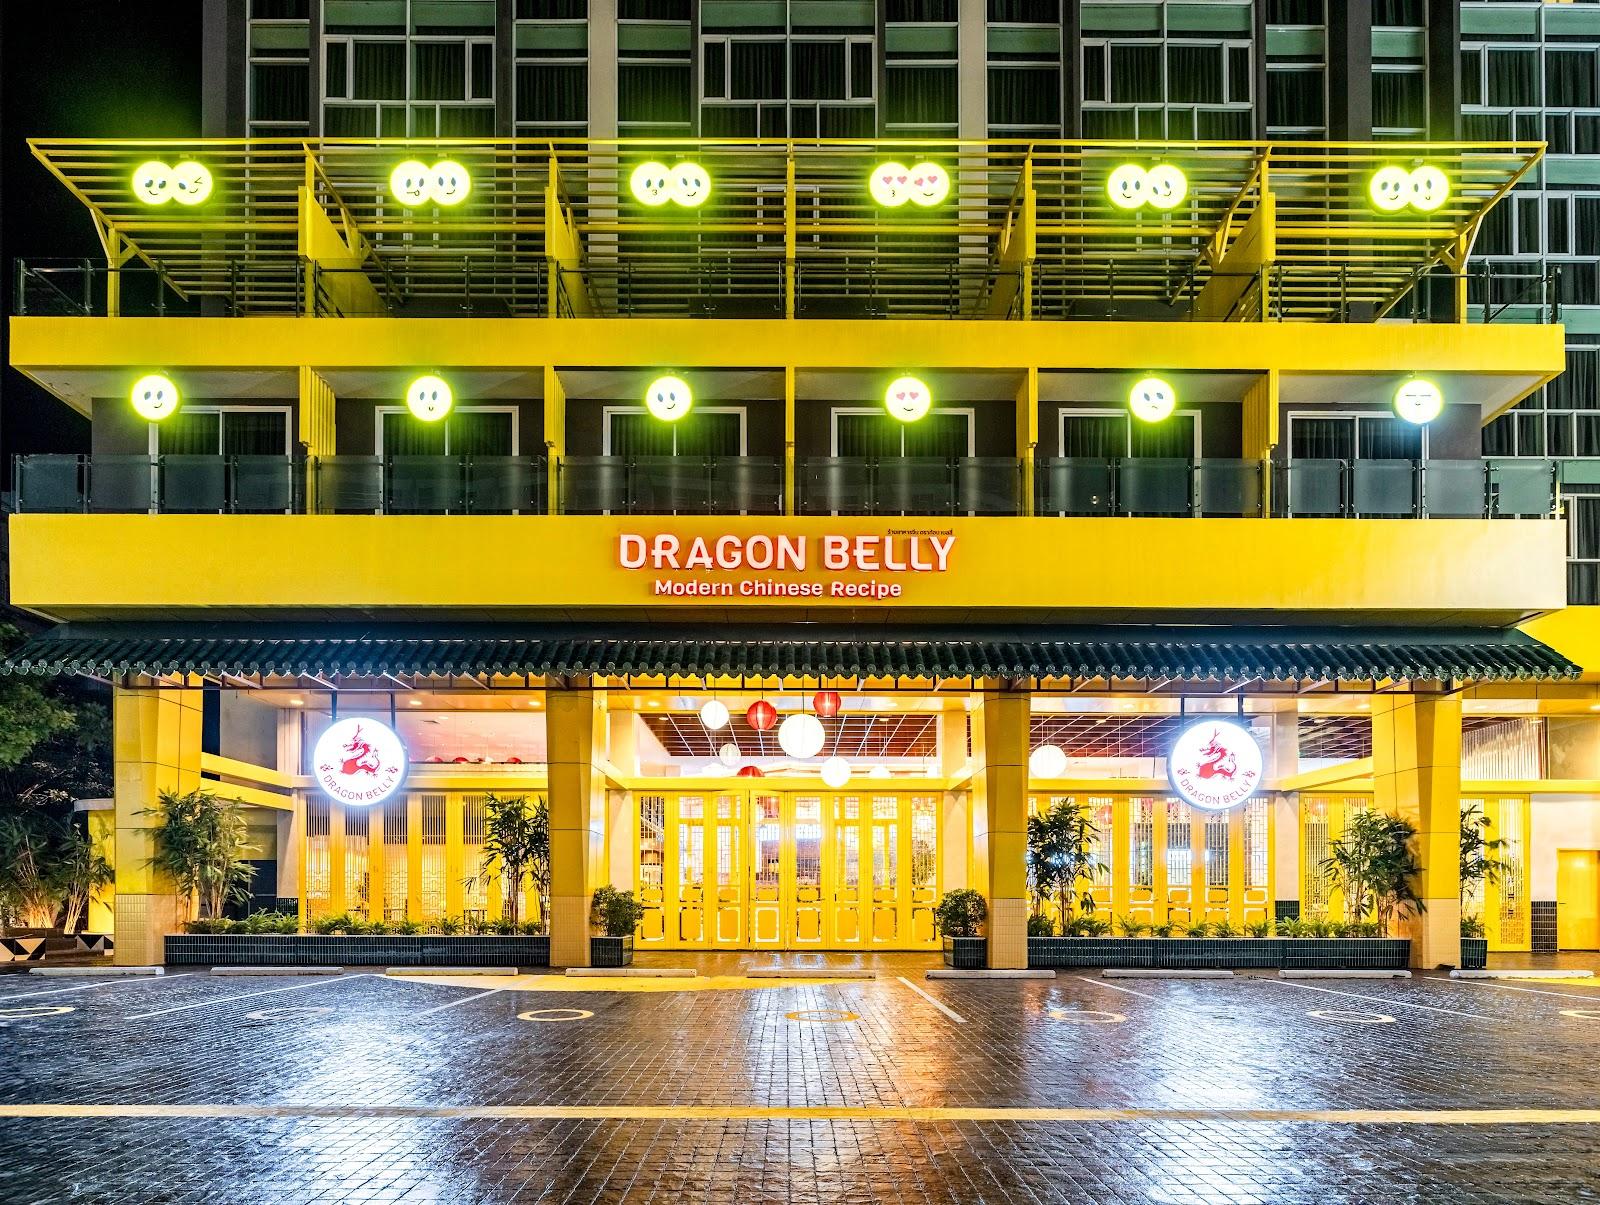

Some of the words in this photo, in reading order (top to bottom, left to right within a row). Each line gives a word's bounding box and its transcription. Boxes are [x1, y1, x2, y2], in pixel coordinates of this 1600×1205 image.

[619, 534, 807, 571] DRAGON
[824, 535, 956, 572] BELLY
[654, 579, 733, 596] Modern
[739, 579, 823, 597] Chinese
[830, 580, 902, 600] Recipe
[323, 774, 363, 800] DRAGON
[366, 775, 394, 799] BELLY
[1180, 778, 1220, 804] DRAGON
[1223, 779, 1251, 803] BELLY
